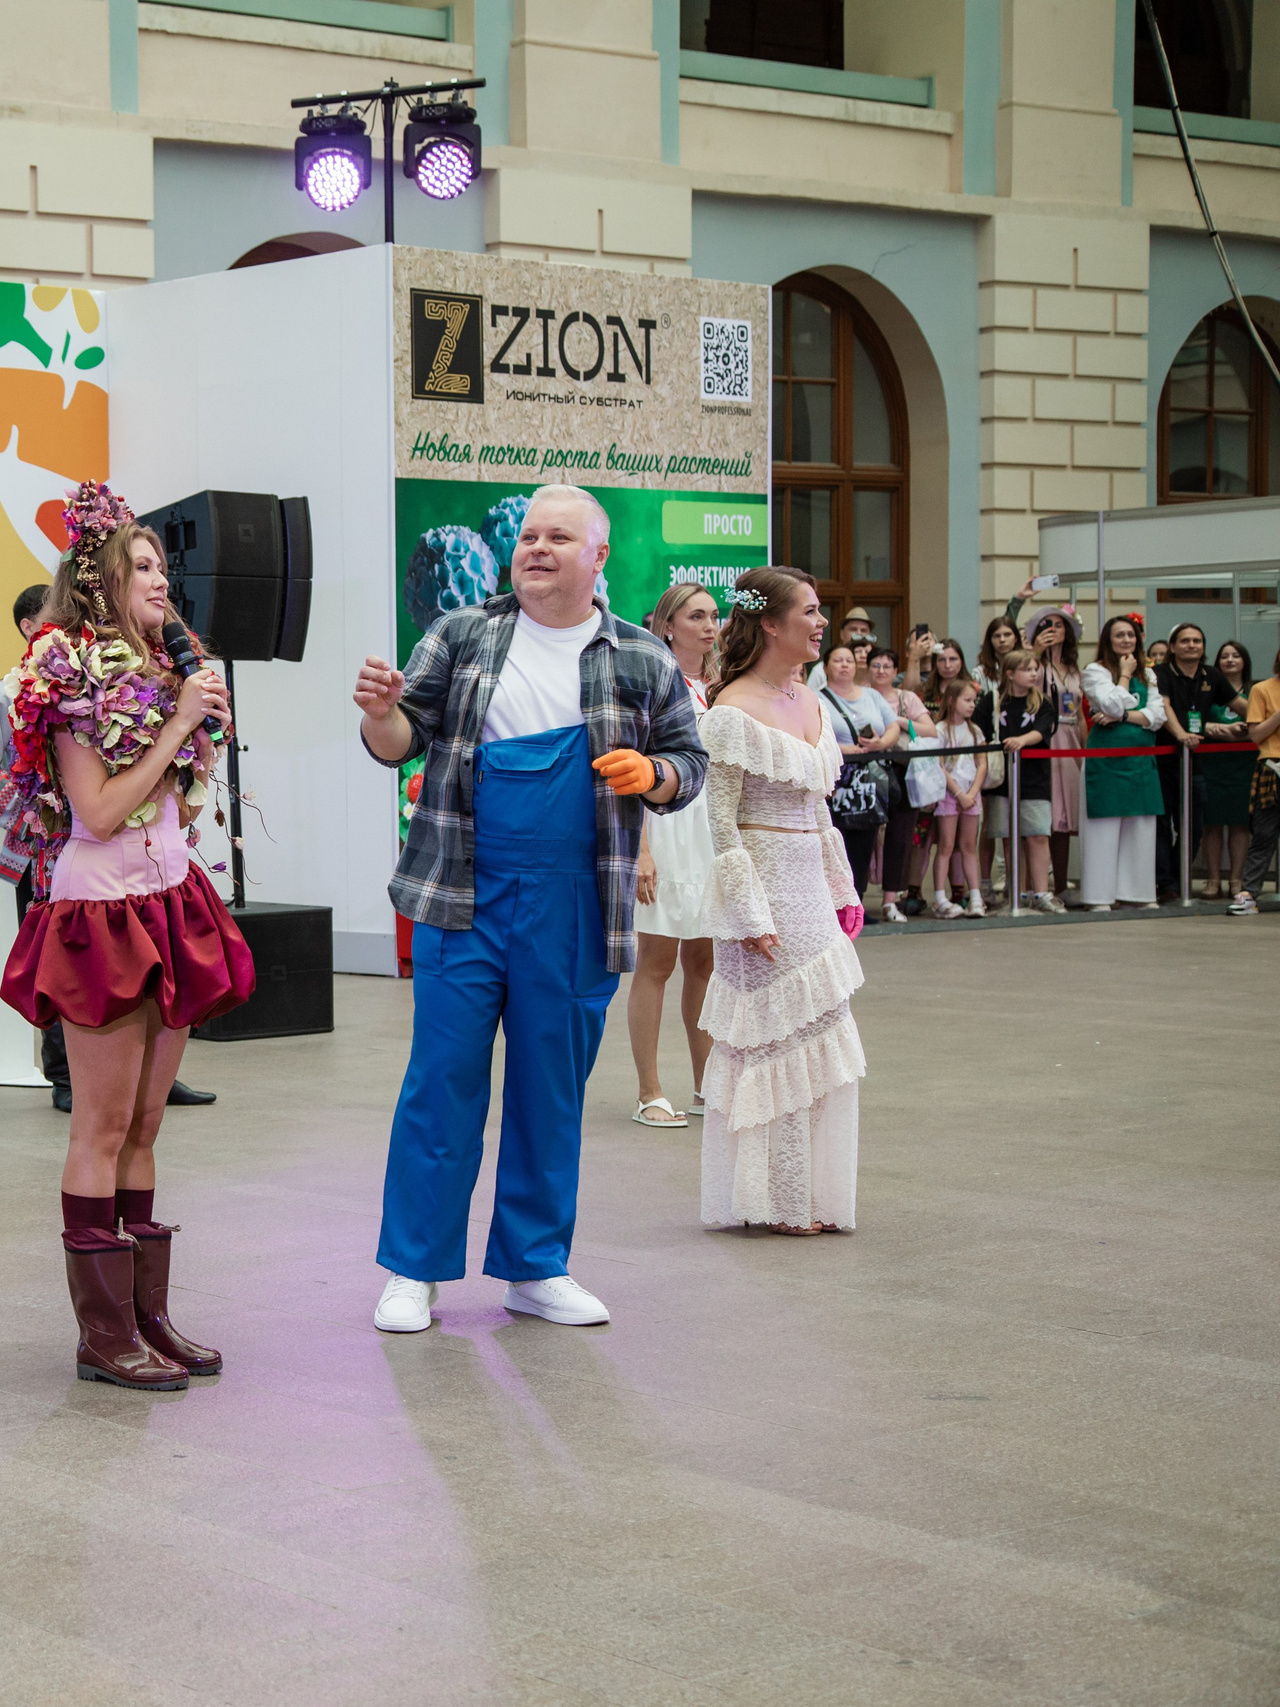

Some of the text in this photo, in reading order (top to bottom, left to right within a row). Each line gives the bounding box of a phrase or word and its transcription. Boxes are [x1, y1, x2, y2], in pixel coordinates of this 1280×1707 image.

[506, 389, 644, 409] ИОНИТНЫЙ СУБСТРАТ
[411, 430, 752, 482] Новая точка роста ваших растений
[703, 513, 753, 536] ПРОСТО
[669, 564, 751, 588] ЭФФЕКТИВ
